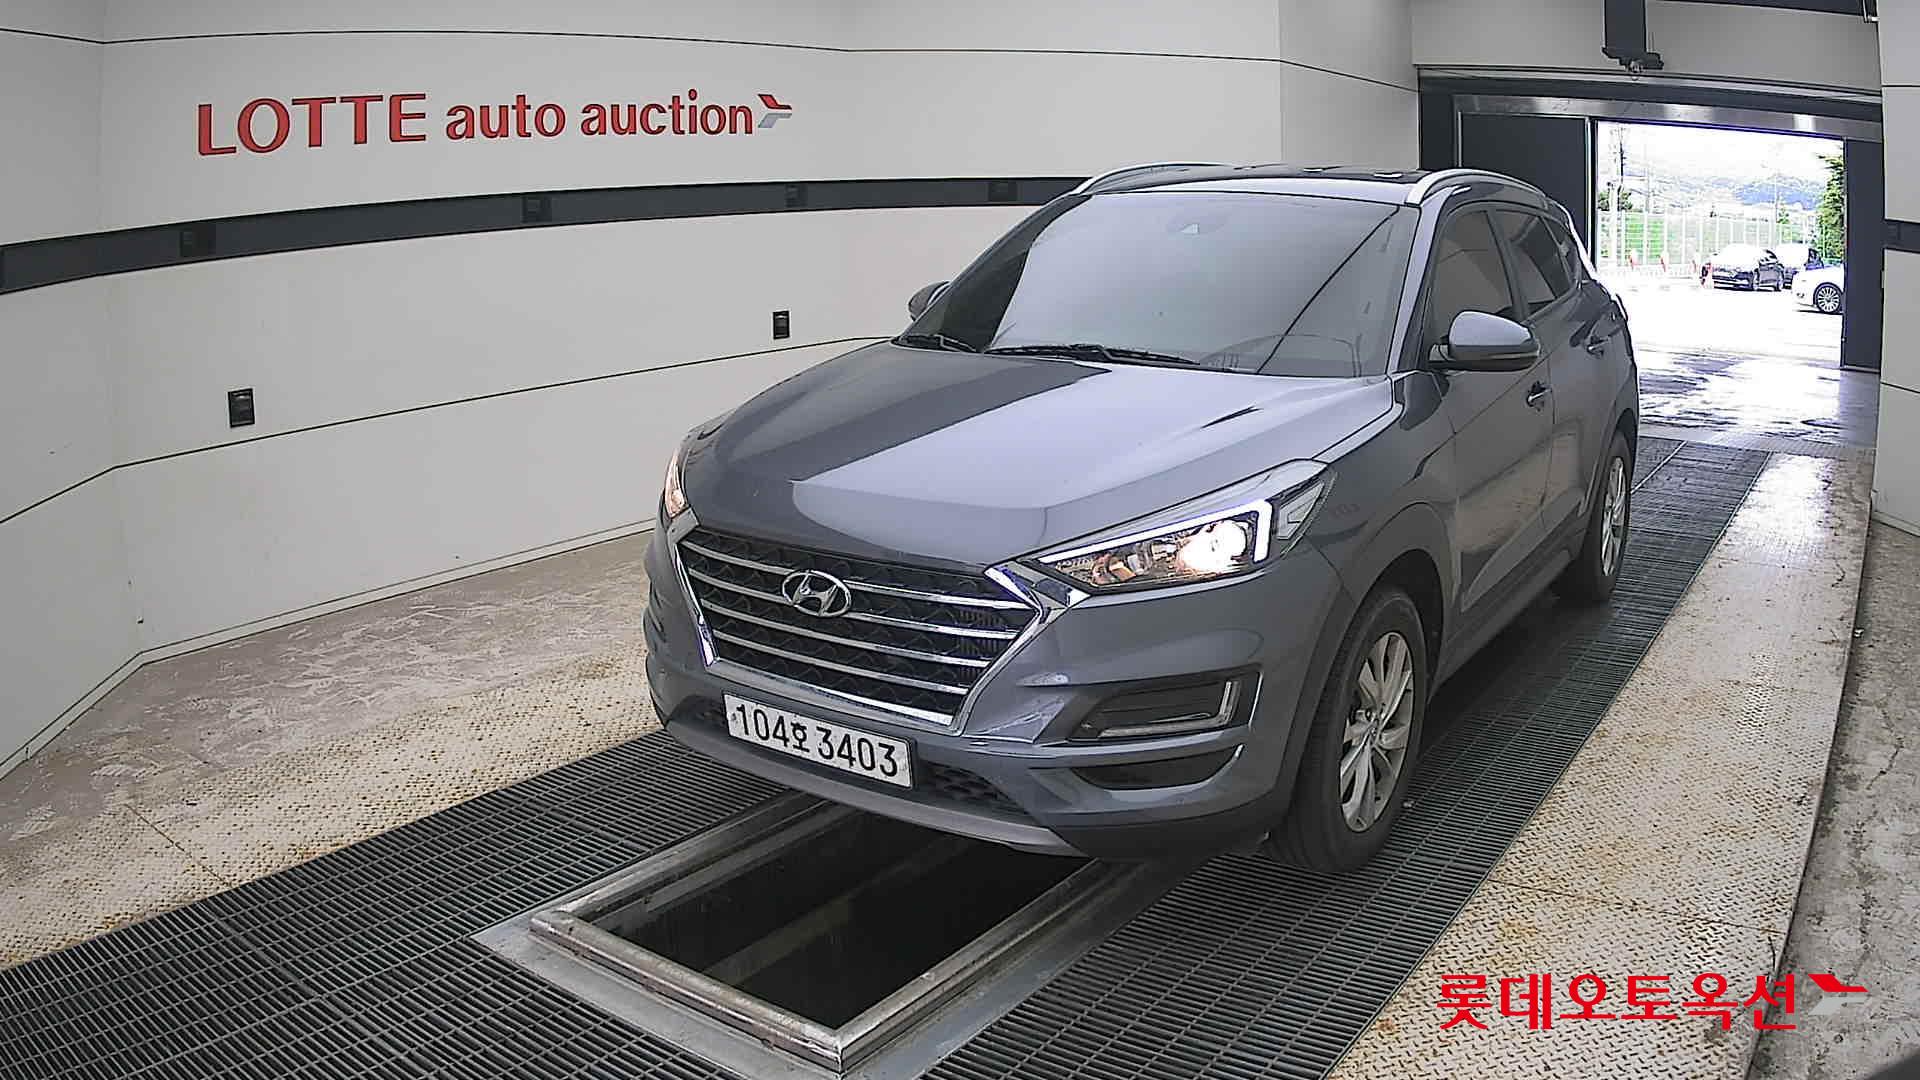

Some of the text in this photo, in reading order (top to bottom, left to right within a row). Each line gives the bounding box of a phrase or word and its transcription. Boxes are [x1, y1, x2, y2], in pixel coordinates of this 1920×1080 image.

[197, 89, 755, 156] LOTTE auto auction
[736, 703, 898, 778] 104호 3403
